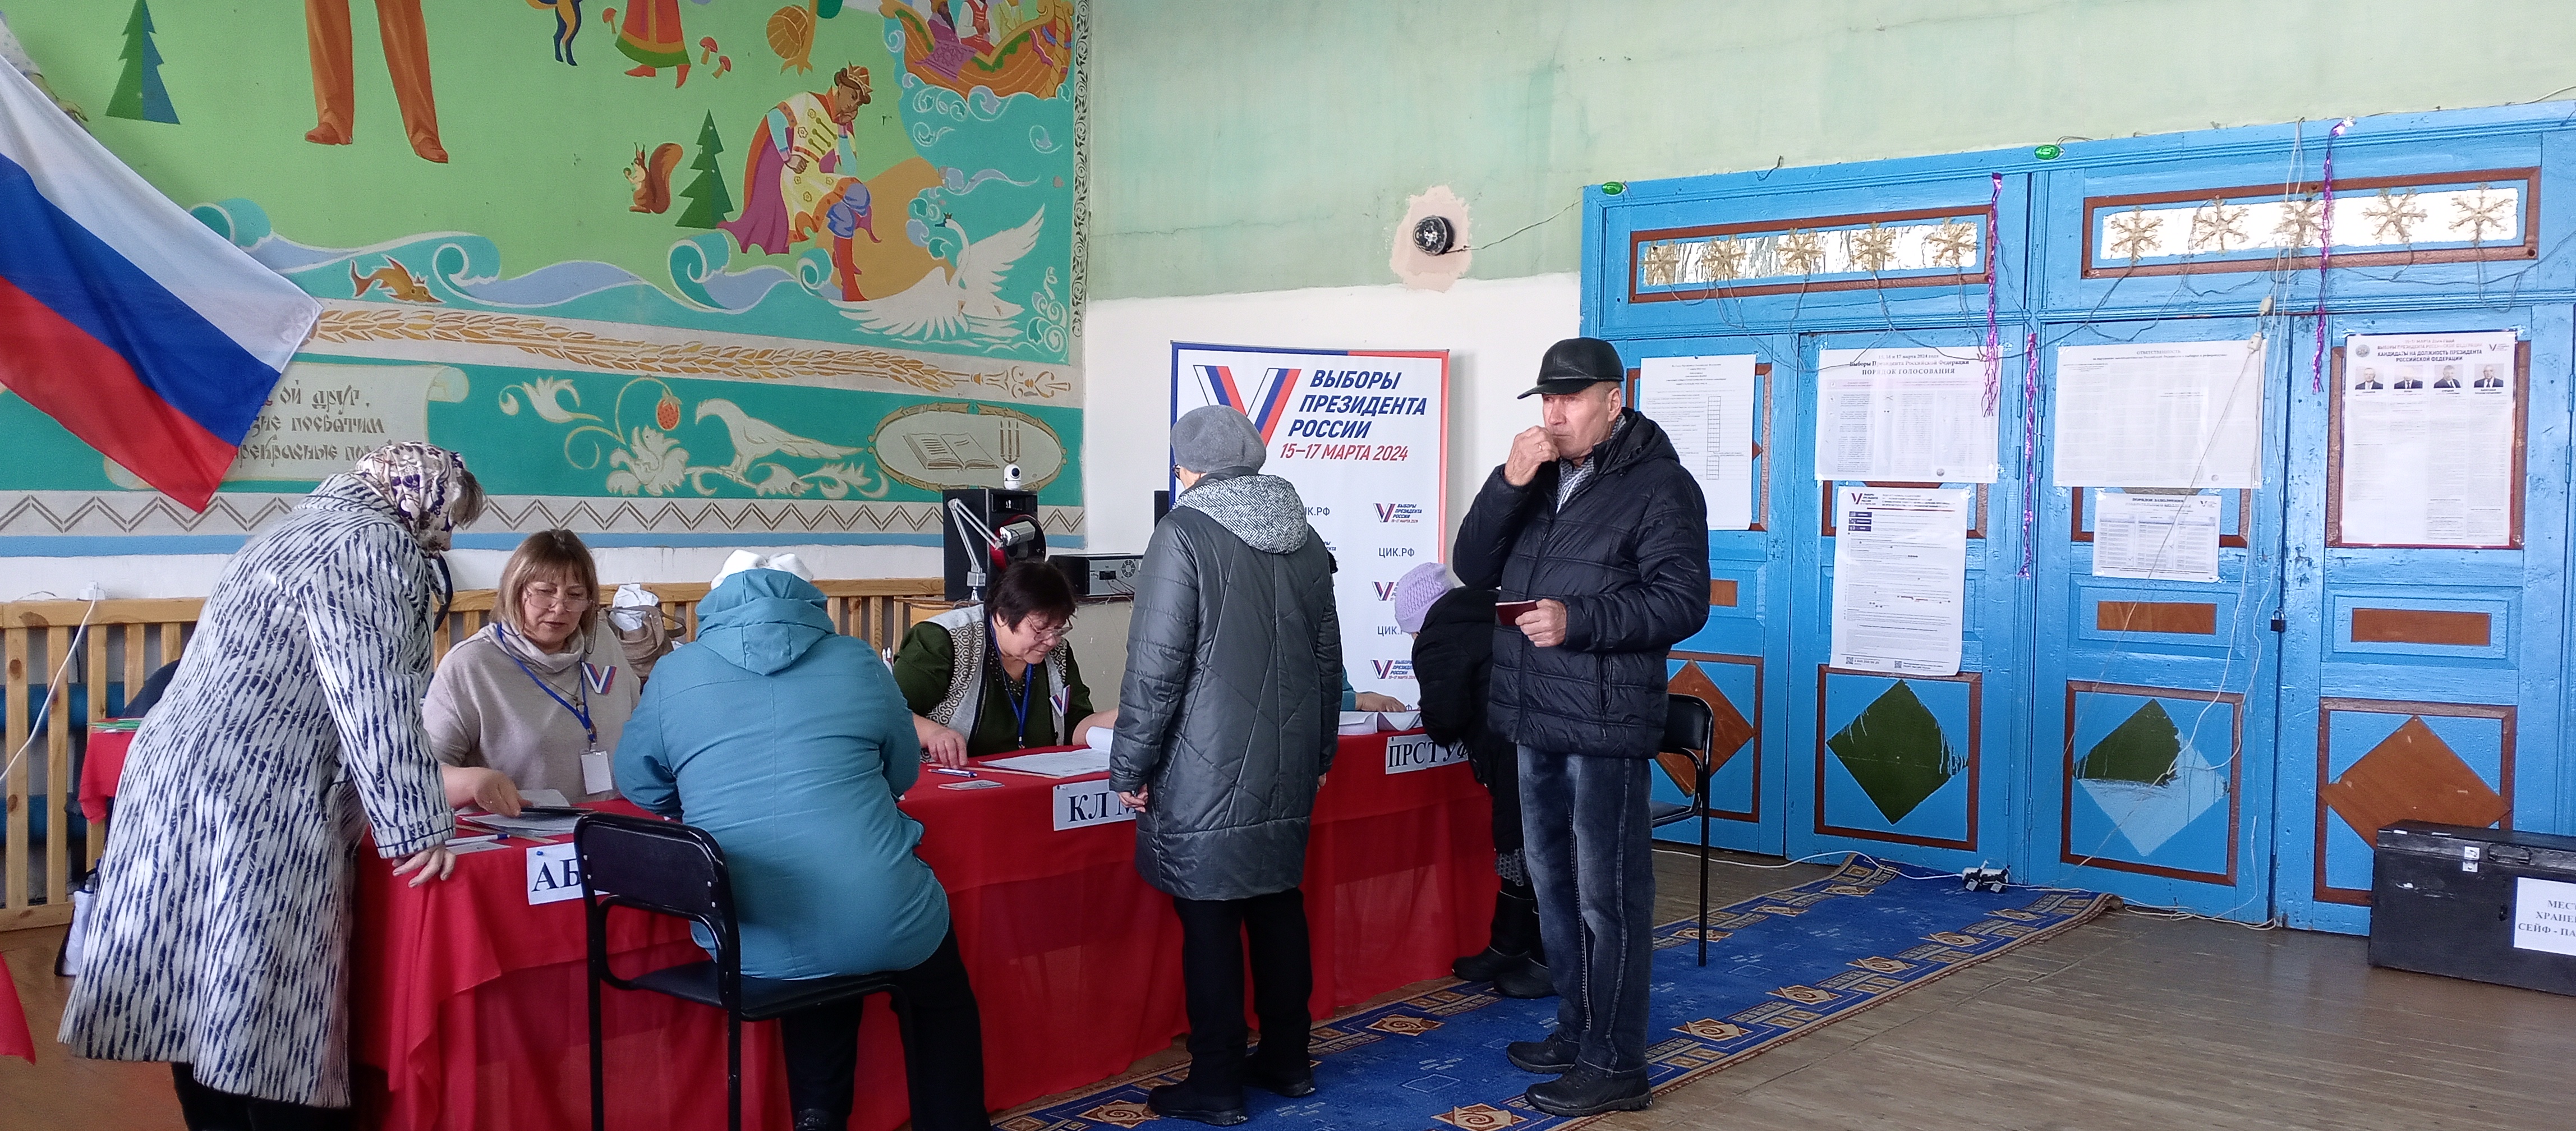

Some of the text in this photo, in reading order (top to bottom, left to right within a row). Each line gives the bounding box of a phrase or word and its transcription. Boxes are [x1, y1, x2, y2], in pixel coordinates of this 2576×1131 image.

[1310, 370, 1402, 389] ВЫБОРЫ
[1299, 394, 1427, 416] ПРЕЗИДЕНТА
[1288, 420, 1372, 438] РОССИИ
[236, 434, 337, 468] рекрасные
[1321, 444, 1371, 461] МАРТА
[1372, 445, 1408, 461] 2024
[1379, 548, 1414, 558] ЦИК.РФ
[1378, 626, 1402, 637] ЦИК.
[1068, 792, 1108, 822] КЛ
[2518, 923, 2551, 933] СЕЙФ
